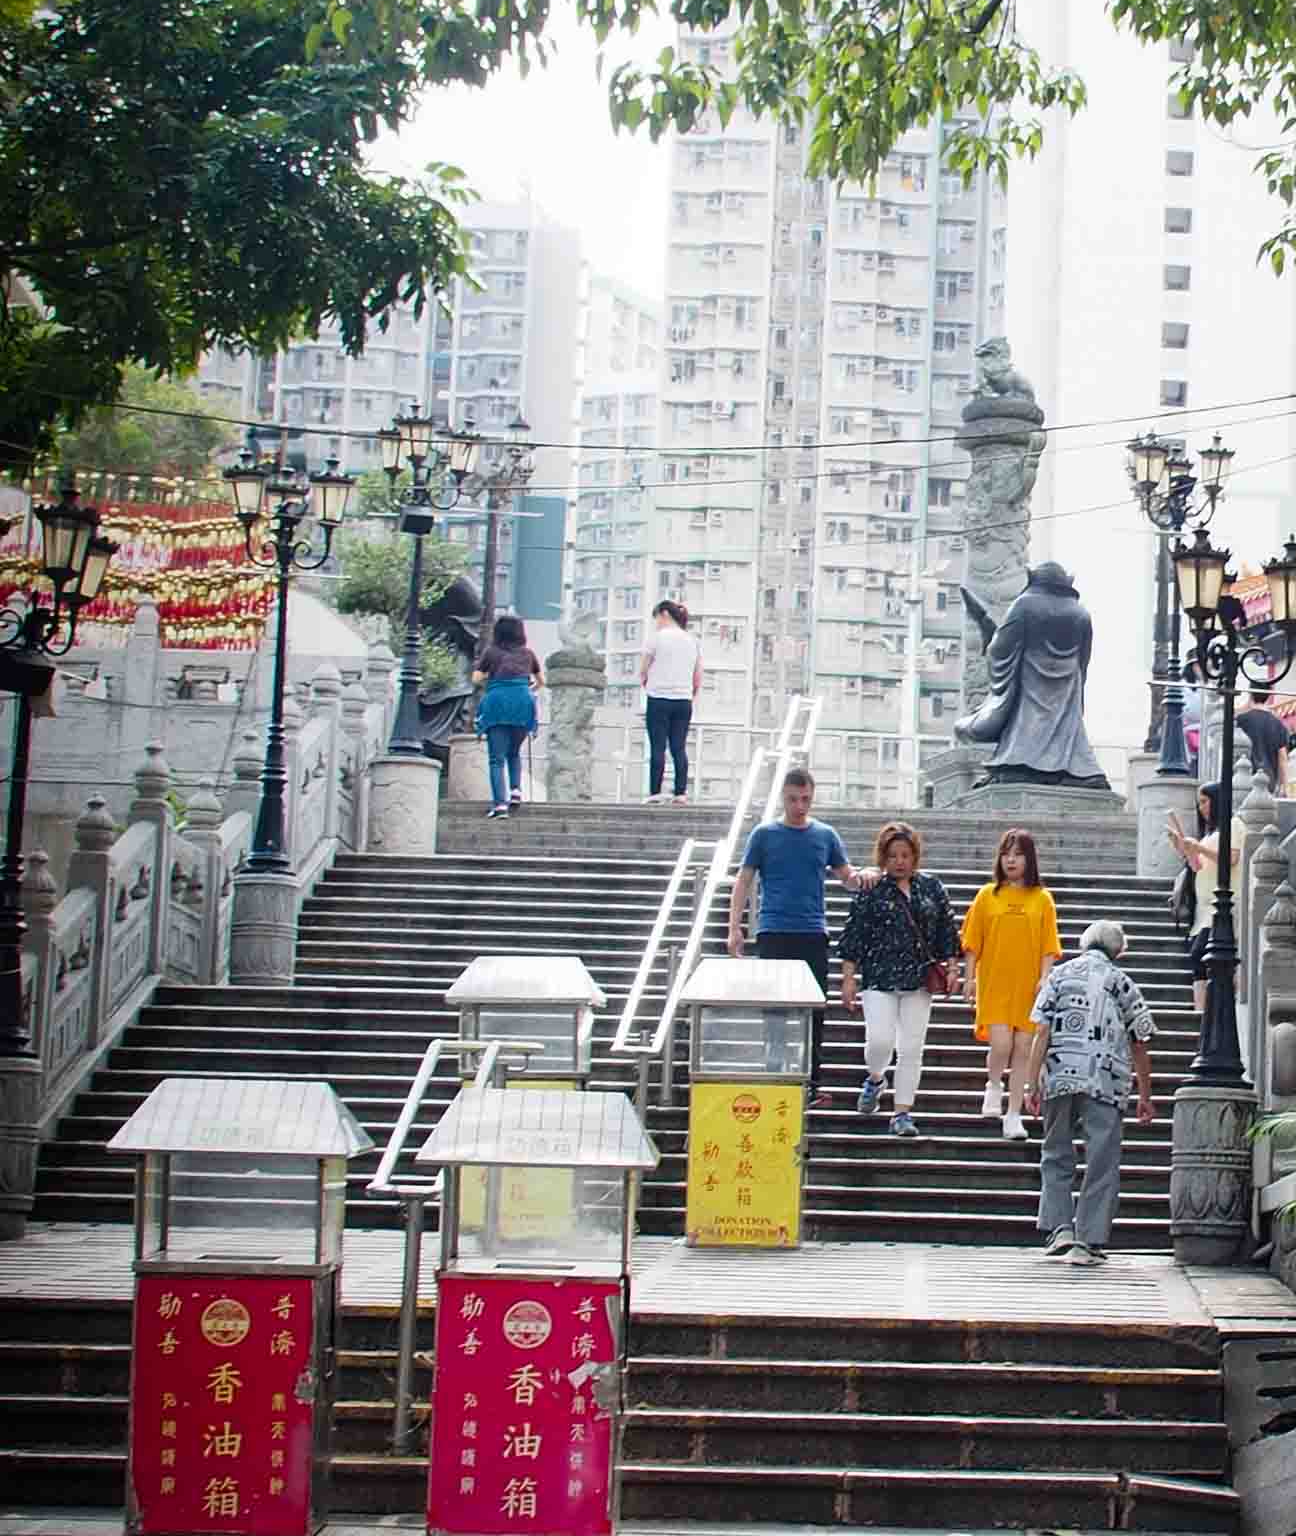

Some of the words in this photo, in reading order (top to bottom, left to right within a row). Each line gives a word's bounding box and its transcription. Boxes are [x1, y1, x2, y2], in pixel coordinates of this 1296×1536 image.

[156, 1291, 183, 1355] 勸善
[458, 1292, 485, 1356] 勸善
[201, 1362, 243, 1519] 香油箱
[499, 1363, 544, 1519] 香油箱
